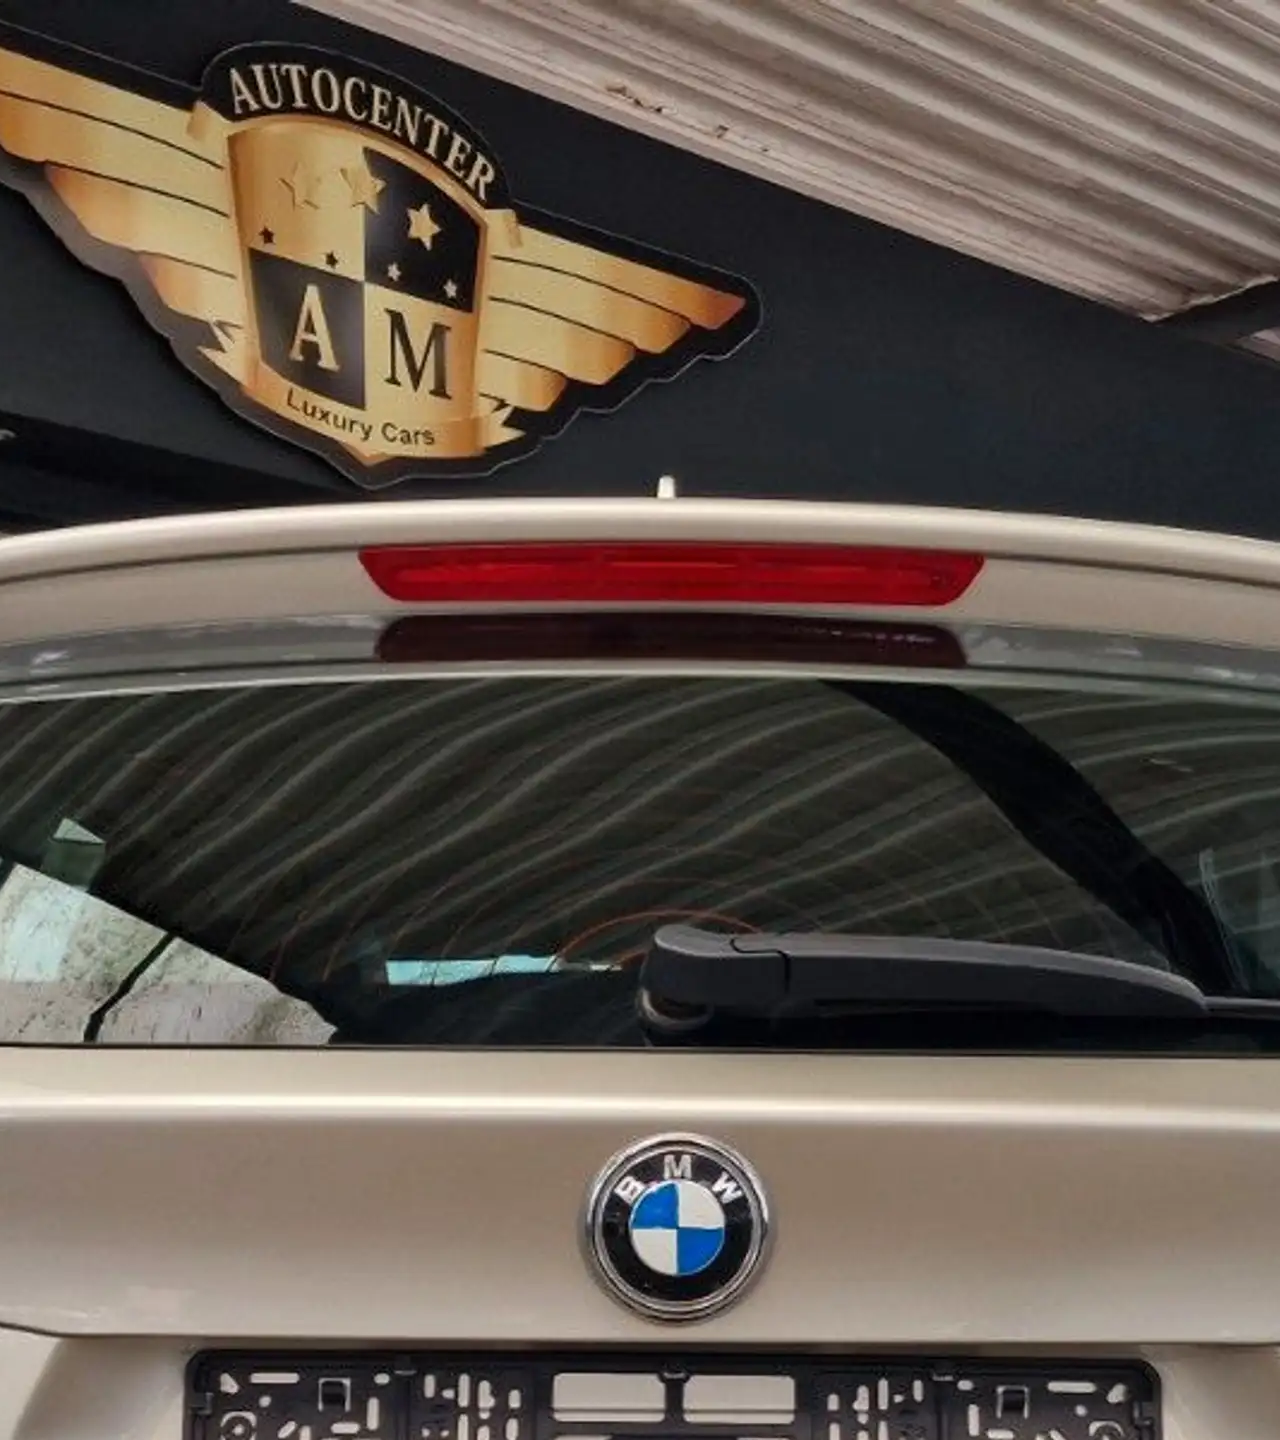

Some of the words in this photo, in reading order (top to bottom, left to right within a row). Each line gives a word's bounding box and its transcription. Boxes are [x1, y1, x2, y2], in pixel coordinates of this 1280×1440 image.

[228, 62, 498, 201] AUTOCENTER
[288, 284, 340, 372] A
[384, 309, 453, 400] M
[285, 388, 374, 443] Luxury
[382, 422, 437, 448] Cars
[613, 1154, 743, 1205] BMW
